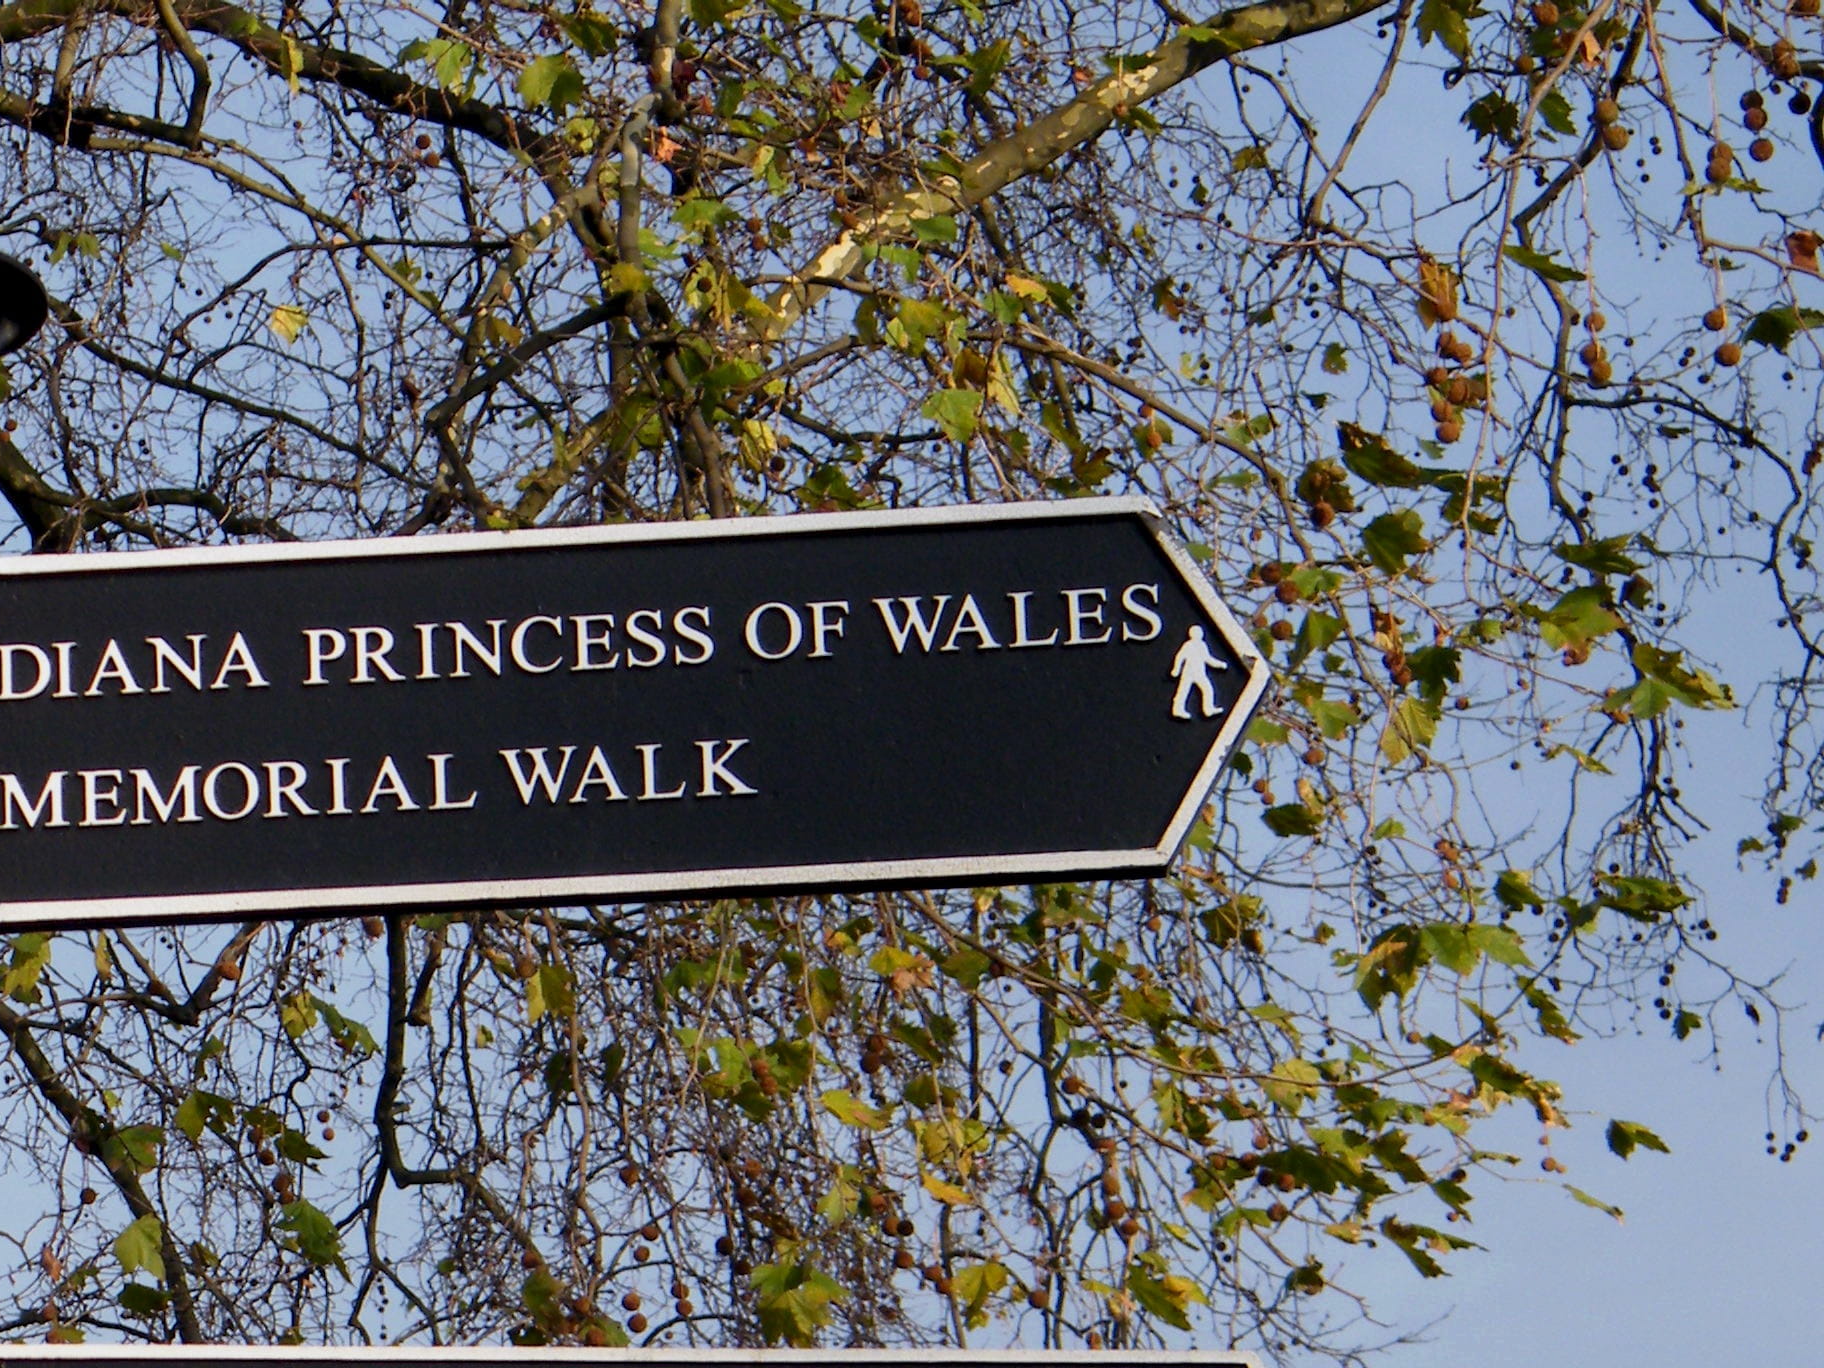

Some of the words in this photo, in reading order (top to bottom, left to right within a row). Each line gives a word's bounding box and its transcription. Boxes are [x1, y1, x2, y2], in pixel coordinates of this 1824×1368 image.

[303, 607, 713, 684] PRINCESS
[746, 601, 849, 658] OF
[873, 584, 1161, 653] WALES
[499, 739, 757, 804] WALK
